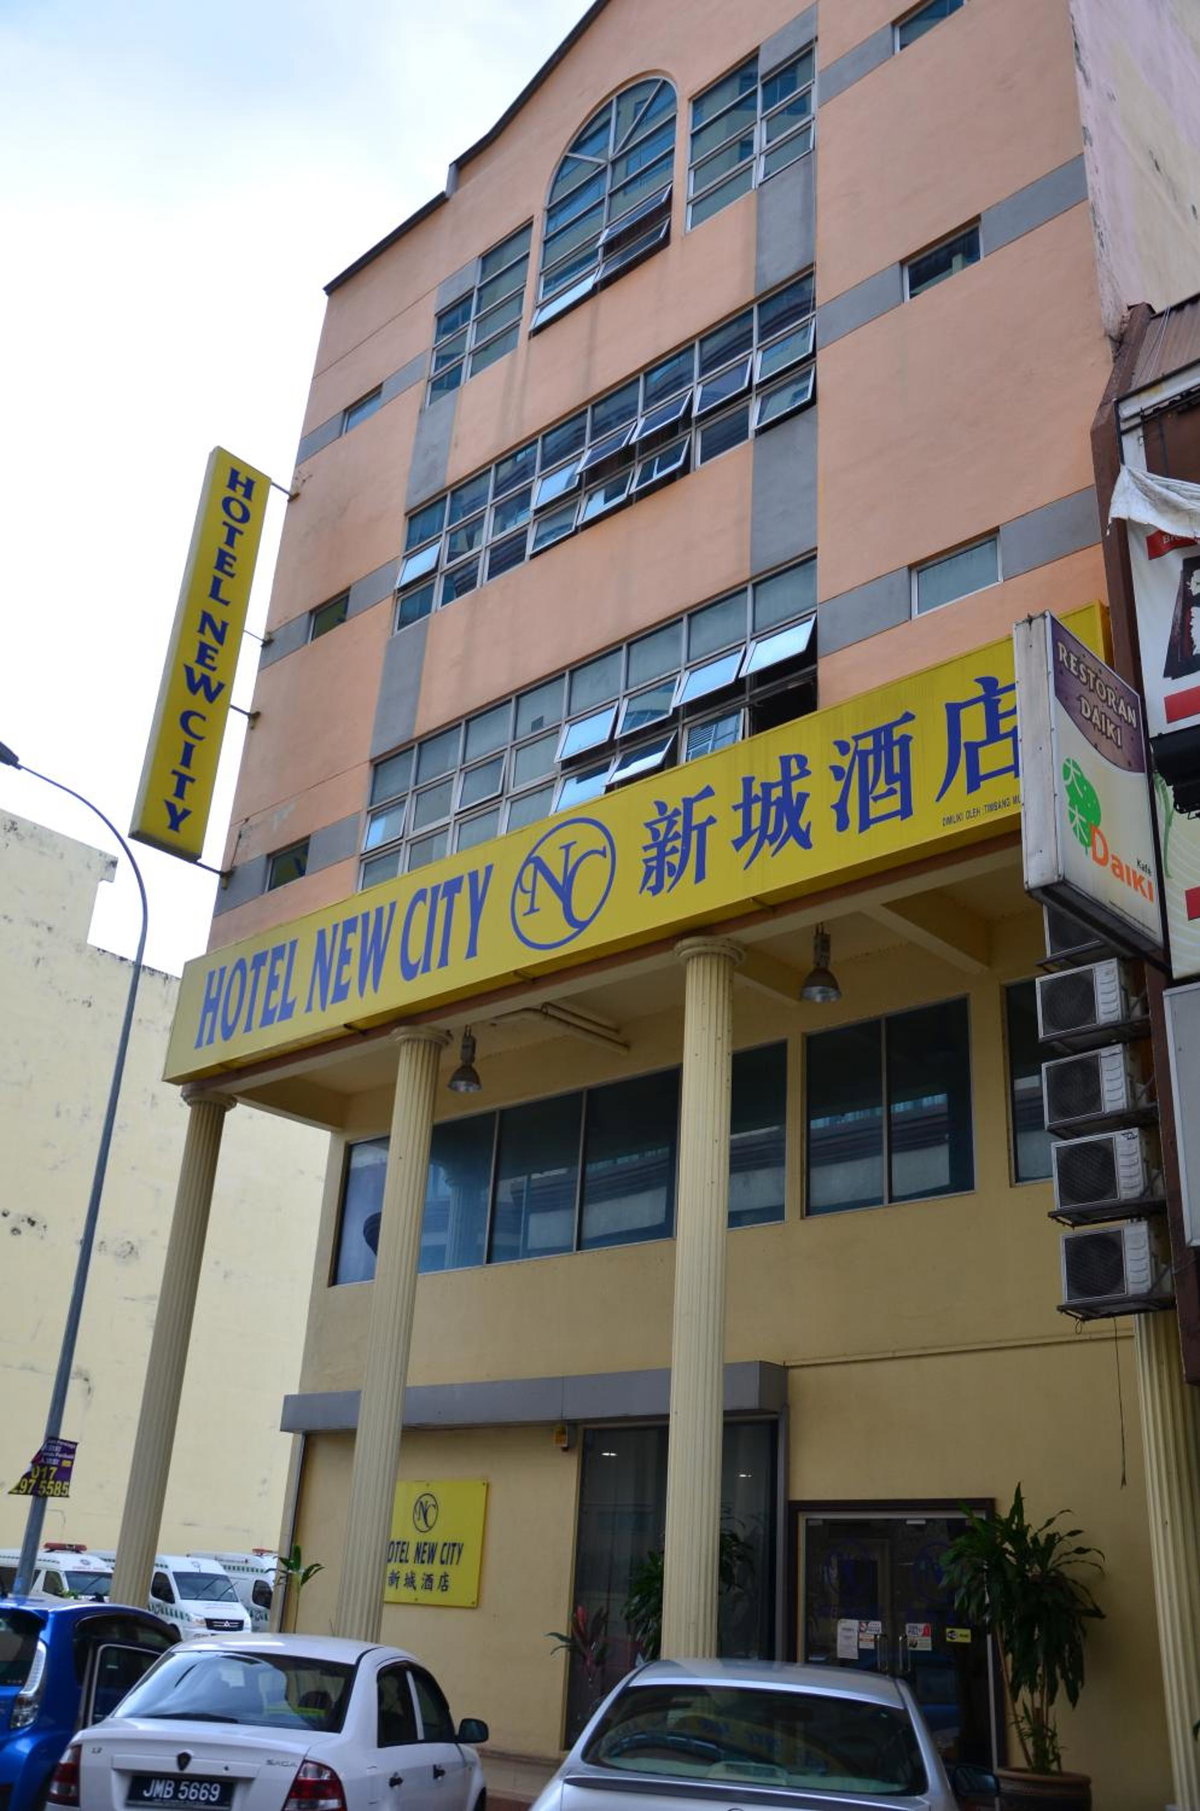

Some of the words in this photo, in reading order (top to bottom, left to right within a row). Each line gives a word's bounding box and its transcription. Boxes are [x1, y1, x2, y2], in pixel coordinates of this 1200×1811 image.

[208, 467, 256, 607] HOTEL
[183, 610, 230, 704] NEW
[1058, 641, 1137, 729] RESTORAN
[1079, 696, 1122, 748] DAIKI
[163, 709, 207, 834] CITY
[639, 675, 1020, 897] 新城酒店
[194, 938, 300, 1050] HOTEL
[305, 901, 397, 1015] NEW
[400, 863, 494, 983] CITY
[15, 1478, 37, 1494] 97
[386, 1540, 410, 1564] OTEL
[413, 1541, 438, 1565] NEW
[440, 1541, 464, 1566] CITY
[388, 1570, 450, 1592] 新城酒店
[143, 1780, 175, 1800] JMB
[177, 1781, 221, 1802] 5669
